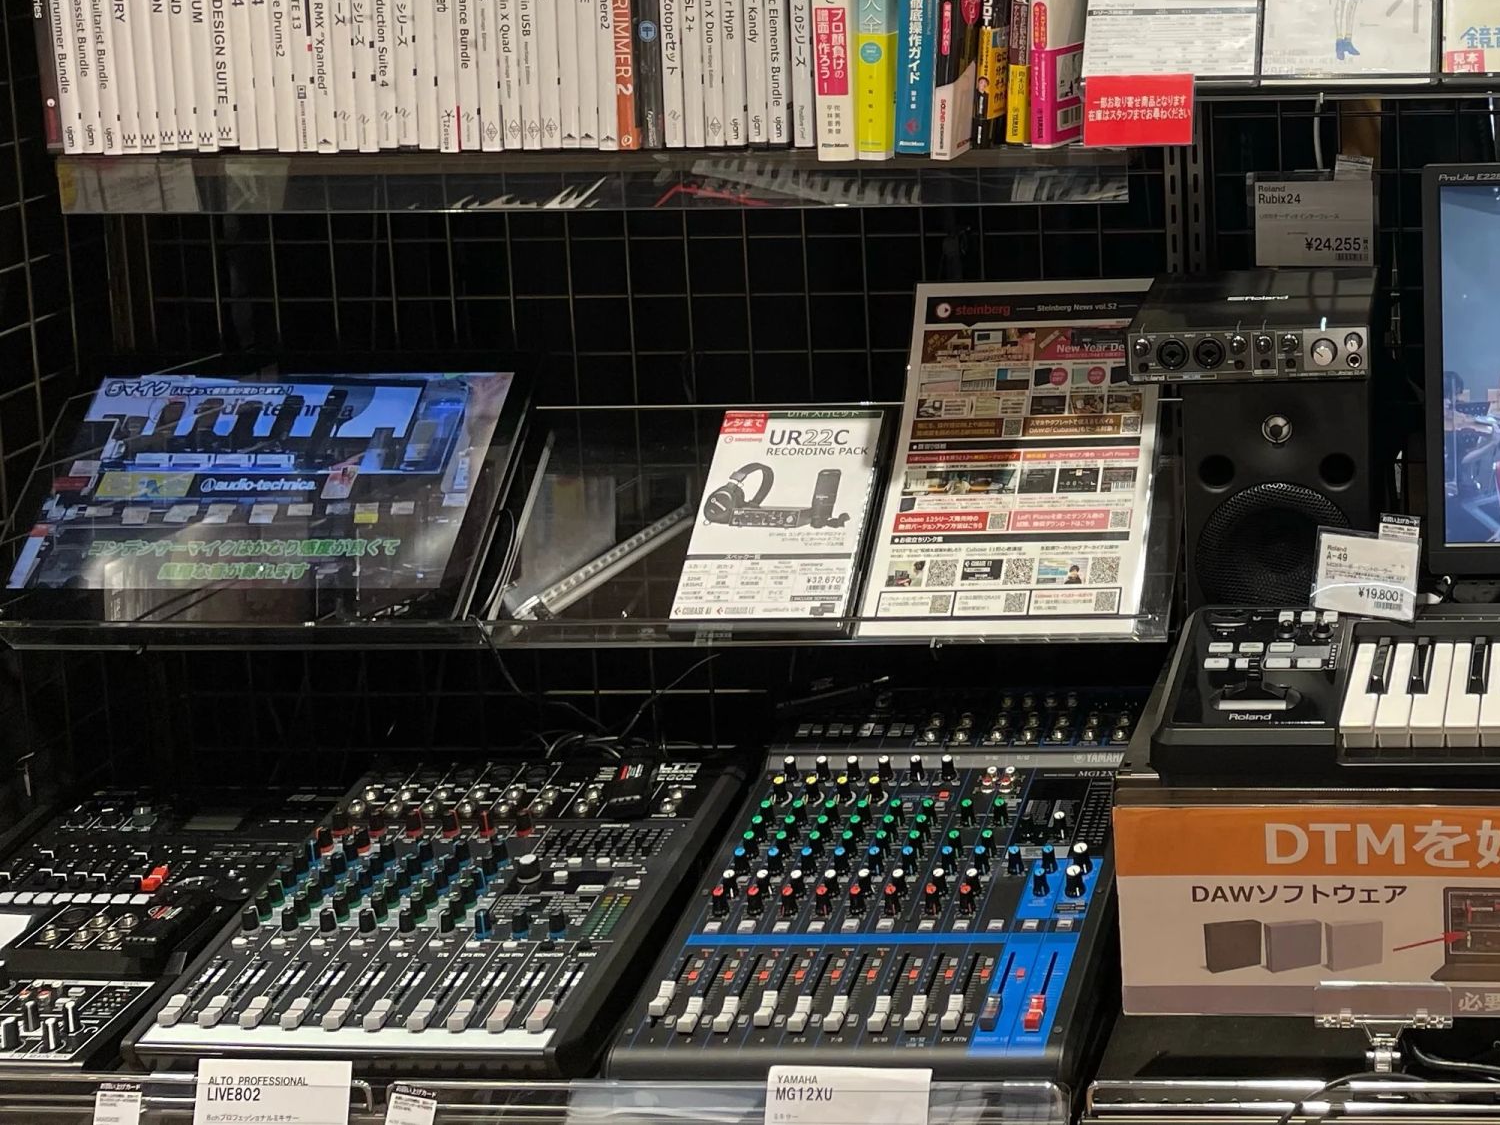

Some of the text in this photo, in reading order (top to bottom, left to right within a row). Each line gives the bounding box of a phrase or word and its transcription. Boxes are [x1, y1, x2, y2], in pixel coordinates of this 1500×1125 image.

[212, 0, 225, 56] DESIGN
[292, 16, 301, 30] 13
[274, 12, 285, 57] Drums2
[58, 53, 68, 94] Bundle
[216, 61, 228, 104] SUITE
[1258, 185, 1285, 193] Roland
[1258, 193, 1301, 205] Rubix24
[1305, 238, 1361, 252] ¥24,255
[956, 305, 1011, 316] steinberg
[1057, 343, 1106, 353] New Year
[769, 429, 850, 446] UR22C
[766, 447, 869, 456] RECORDING PACK
[1325, 551, 1348, 562] A-49
[1358, 587, 1400, 603] ¥19,800
[1228, 713, 1272, 722] Roland
[1191, 884, 1408, 905] DAWソフトウェア
[208, 1075, 308, 1086] ALTO PROFESSIONAL
[777, 1074, 818, 1085] YAMAHA
[206, 1087, 261, 1103] LIVE802
[775, 1086, 834, 1103] MG12XU
